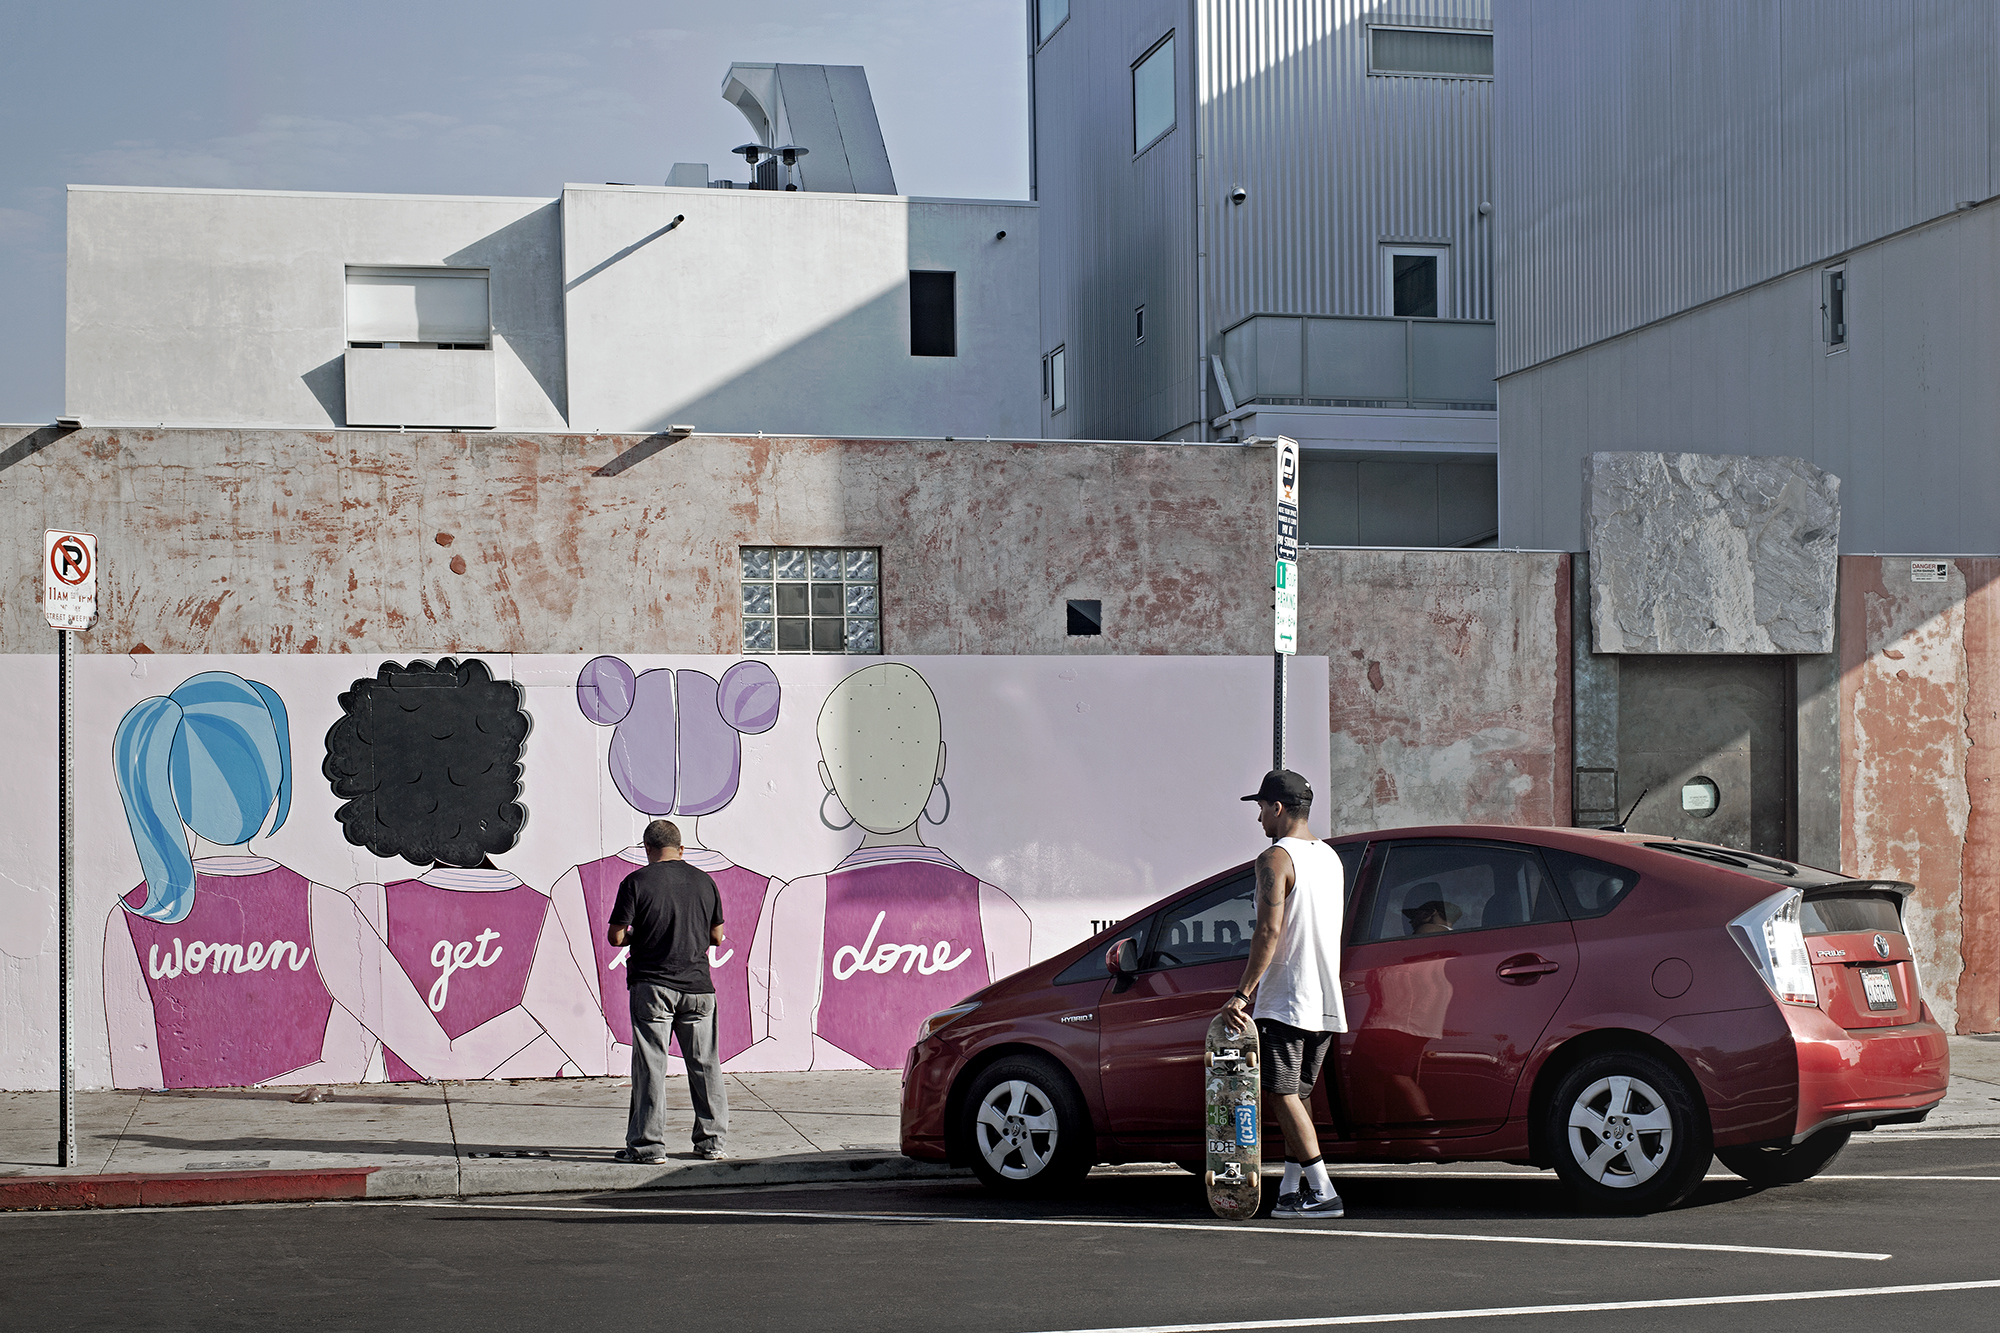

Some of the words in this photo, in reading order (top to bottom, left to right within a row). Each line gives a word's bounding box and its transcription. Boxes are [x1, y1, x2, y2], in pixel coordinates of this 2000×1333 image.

[46, 612, 66, 621] STREET
[68, 613, 96, 622] SWEEPING
[832, 910, 973, 981] done
[1817, 949, 1846, 958] PRIUS
[149, 937, 310, 980] women
[428, 927, 504, 1013] get
[1061, 1014, 1087, 1023] HYBRID
[1219, 1105, 1228, 1125] evo
[1209, 1140, 1236, 1153] DOPE
